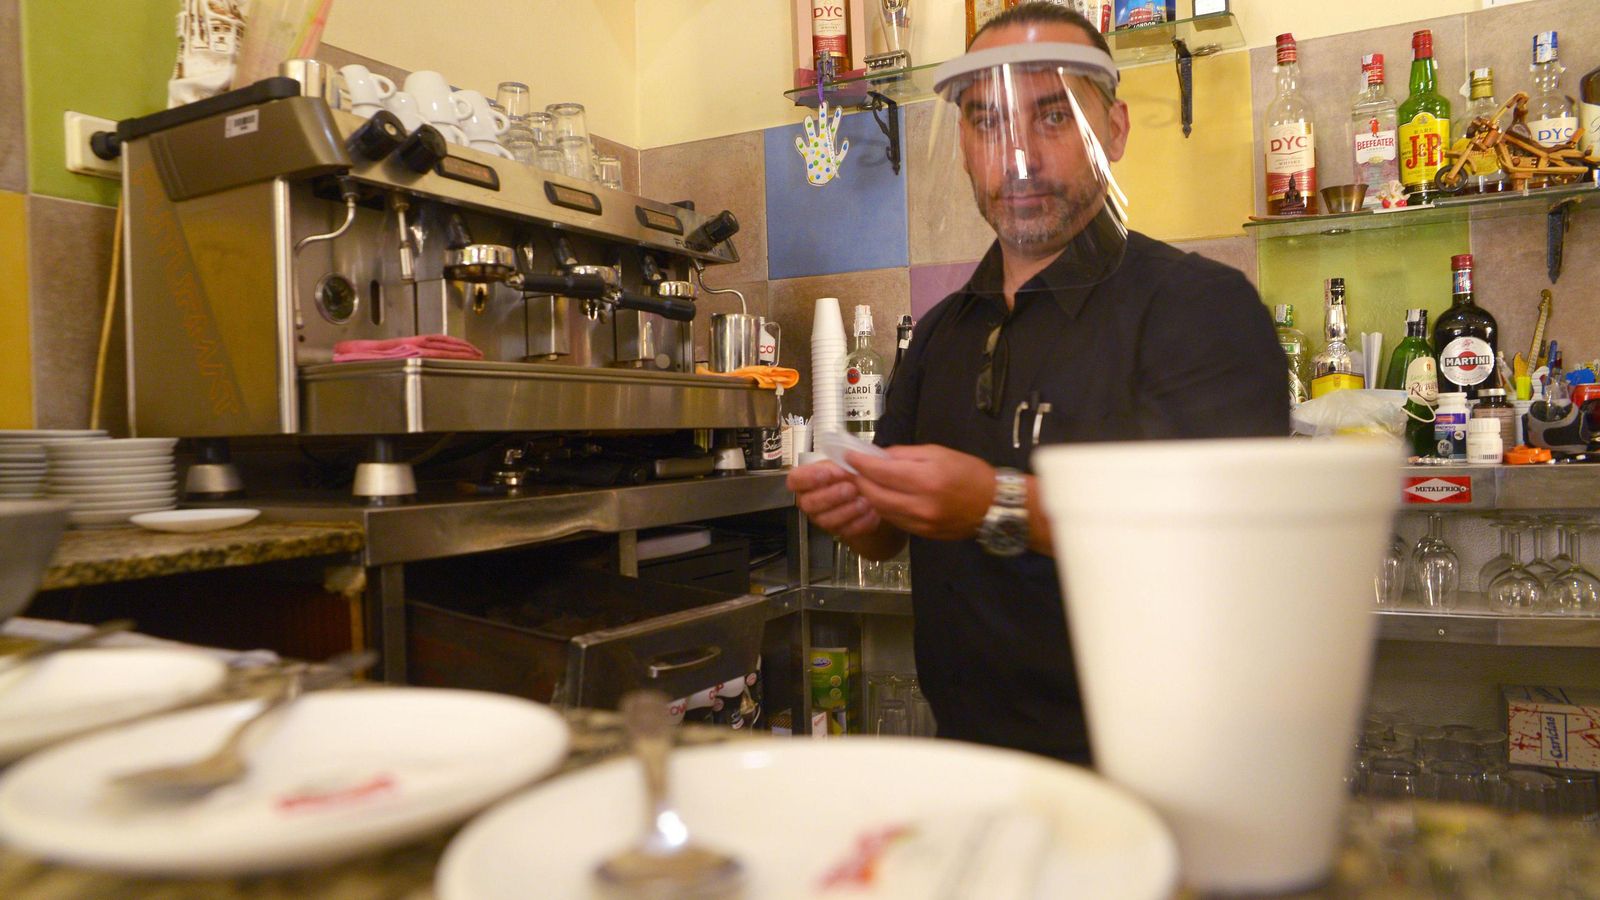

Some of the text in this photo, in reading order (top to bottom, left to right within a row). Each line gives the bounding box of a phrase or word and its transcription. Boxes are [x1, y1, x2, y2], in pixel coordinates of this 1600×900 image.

[813, 5, 843, 18] DYC
[1538, 127, 1573, 141] DYC
[1270, 135, 1308, 152] DYC
[1356, 137, 1394, 151] BEEFEATER
[759, 345, 775, 354] CO
[1446, 356, 1489, 367] MARTINI
